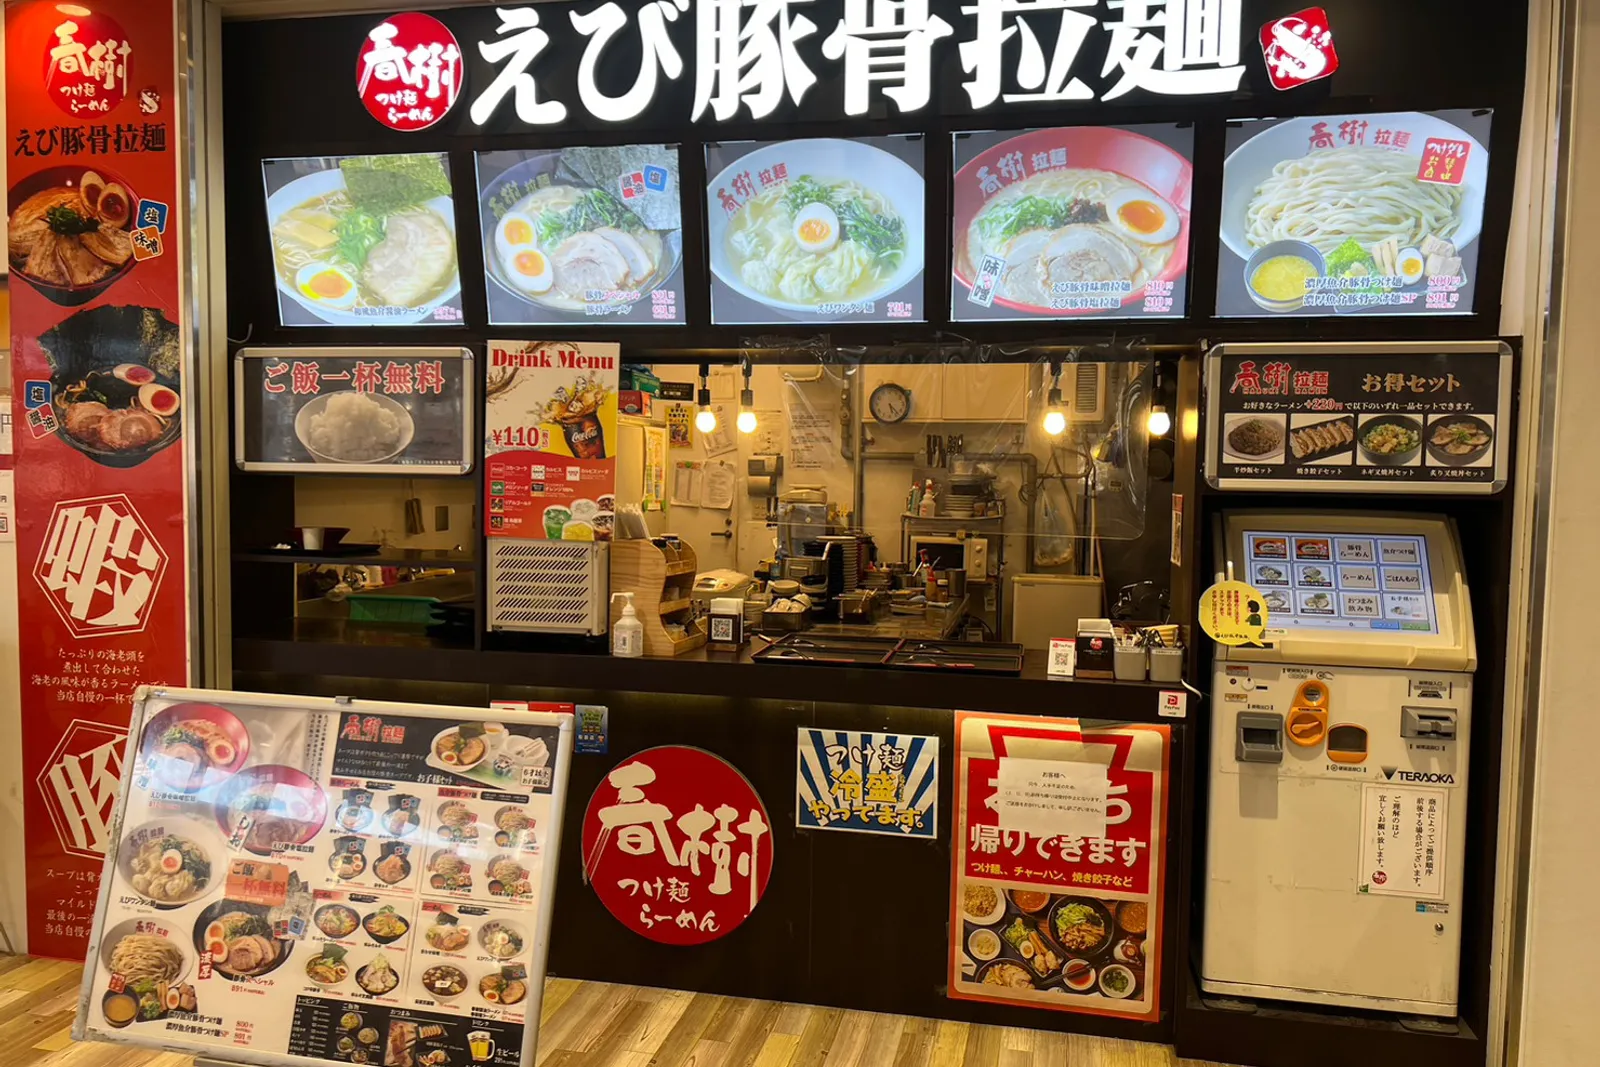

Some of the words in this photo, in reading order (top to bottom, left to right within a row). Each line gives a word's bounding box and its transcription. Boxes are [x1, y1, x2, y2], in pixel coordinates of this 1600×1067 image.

[470, 0, 1246, 126] えび豚骨拉麺
[60, 83, 96, 98] つけ麺
[71, 98, 110, 113] らーめん
[387, 106, 434, 124] らーめん
[14, 122, 167, 157] えび豚骨拉麺
[1374, 128, 1411, 148] 拉麺
[492, 348, 552, 368] Drink
[558, 350, 614, 371] Menu
[264, 361, 445, 394] ご飯一杯無料
[1293, 371, 1329, 388] 拉麺
[1361, 373, 1460, 392] お得セット
[492, 426, 540, 447] ¥110
[58, 648, 145, 662] たっぷりの海老頭を
[63, 662, 140, 676] 煮出して合わせた
[32, 674, 169, 690] 海老の風味が香るラーメ
[825, 743, 905, 770] つけ麺
[828, 768, 897, 804] 冷盛
[1398, 771, 1454, 784] TERAOKA
[808, 799, 924, 828] やってます。
[971, 823, 1146, 868] 帰りできます
[617, 876, 691, 903] つけ麺
[640, 903, 720, 932] らーめん
